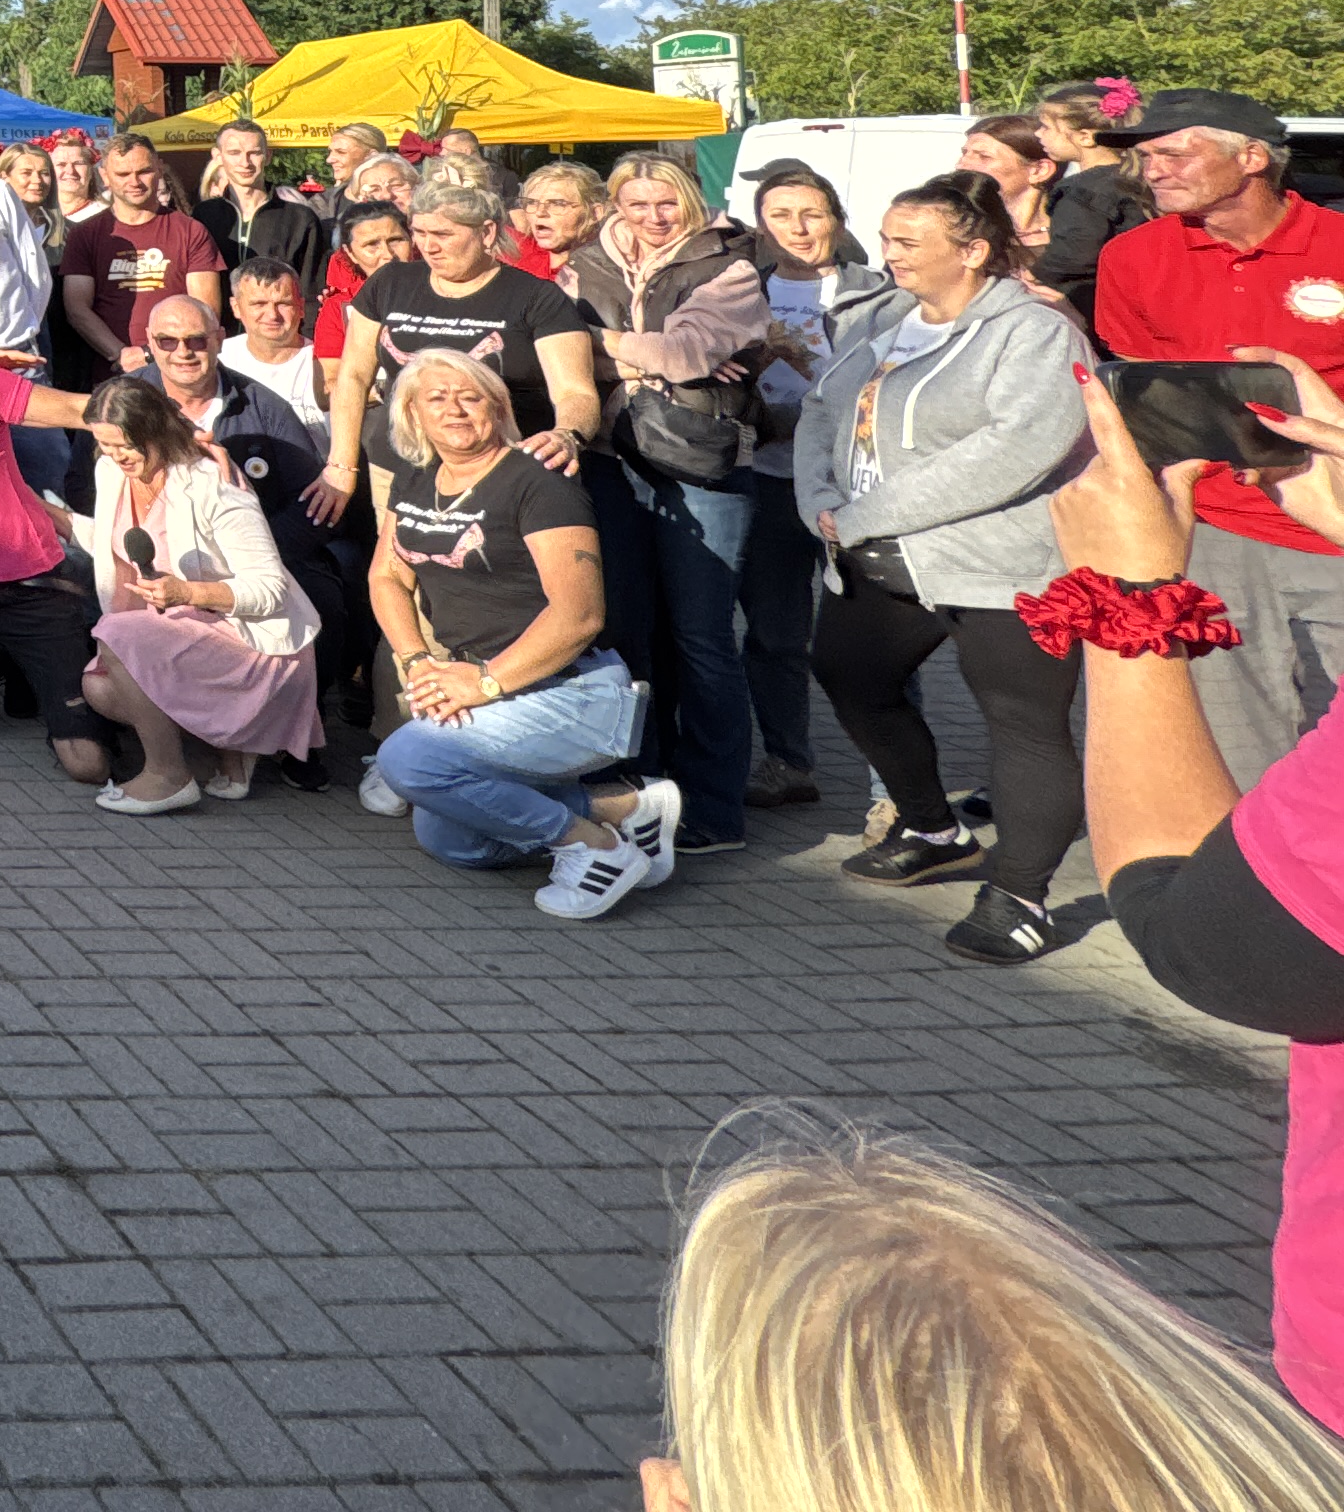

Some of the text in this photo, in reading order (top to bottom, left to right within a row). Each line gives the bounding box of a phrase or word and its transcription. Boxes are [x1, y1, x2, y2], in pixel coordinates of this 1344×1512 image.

[12, 128, 45, 140] JOKER
[264, 124, 293, 138] skich
[295, 122, 340, 141] „Parafi
